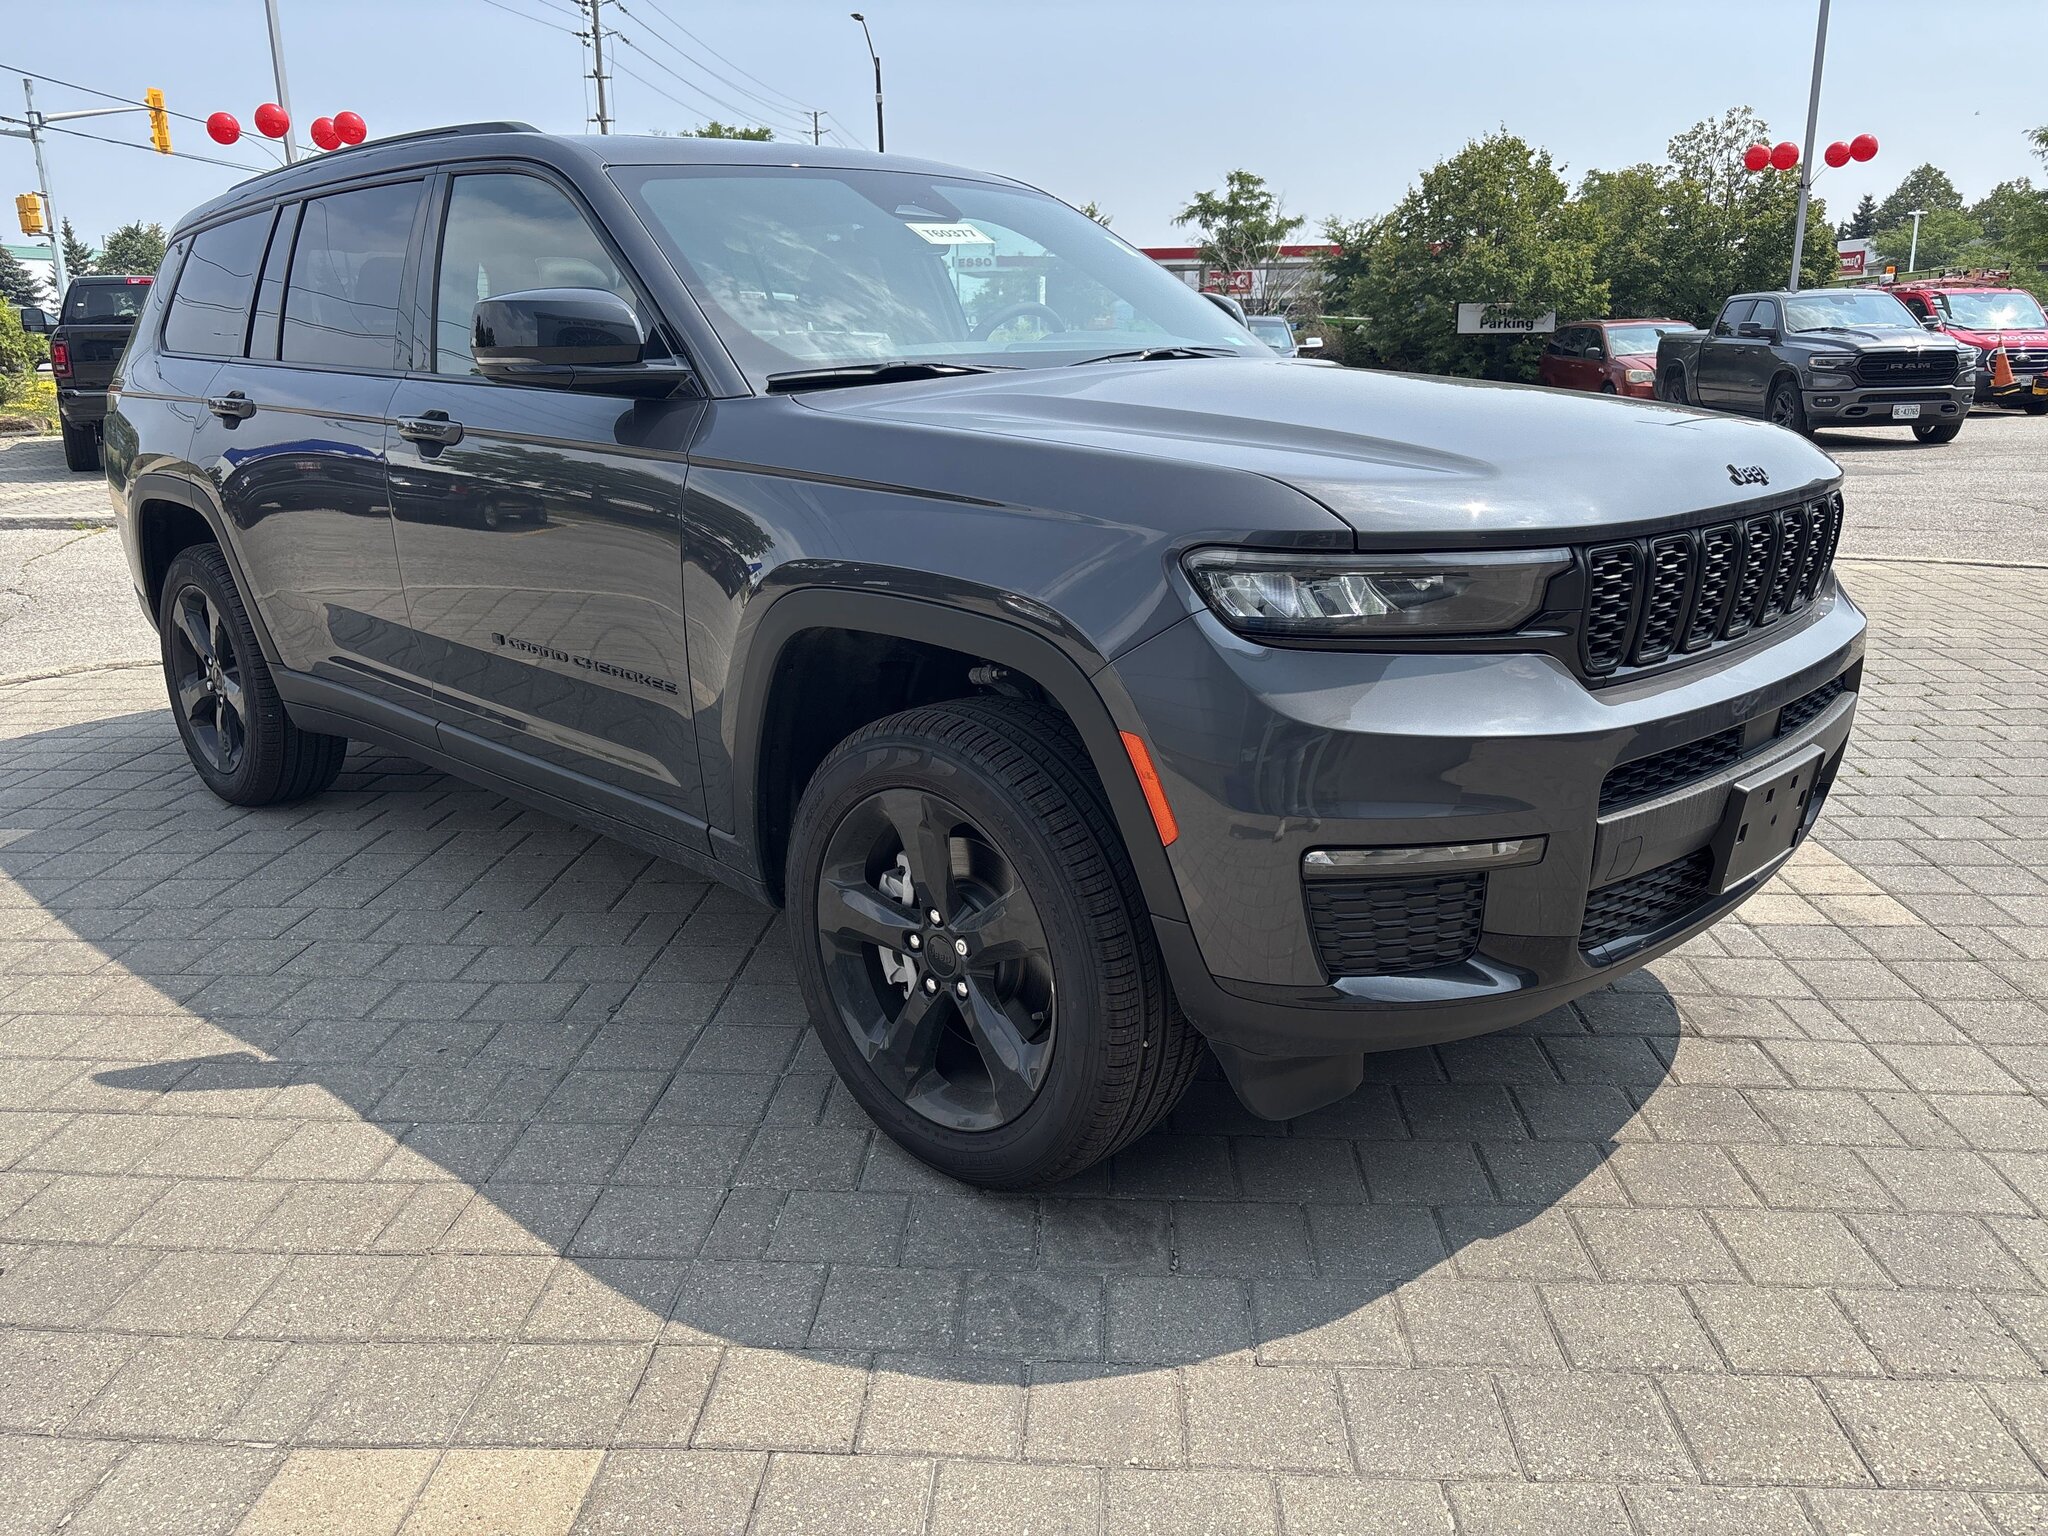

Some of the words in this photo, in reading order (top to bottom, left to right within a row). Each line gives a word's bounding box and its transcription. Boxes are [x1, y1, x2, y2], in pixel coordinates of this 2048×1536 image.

[921, 229, 977, 238] T60377
[957, 257, 993, 268] ESSO
[1479, 318, 1535, 332] Parking
[1725, 463, 1770, 486] Jeep
[508, 638, 569, 662] GRAND
[573, 656, 680, 695] CHEROKEE
